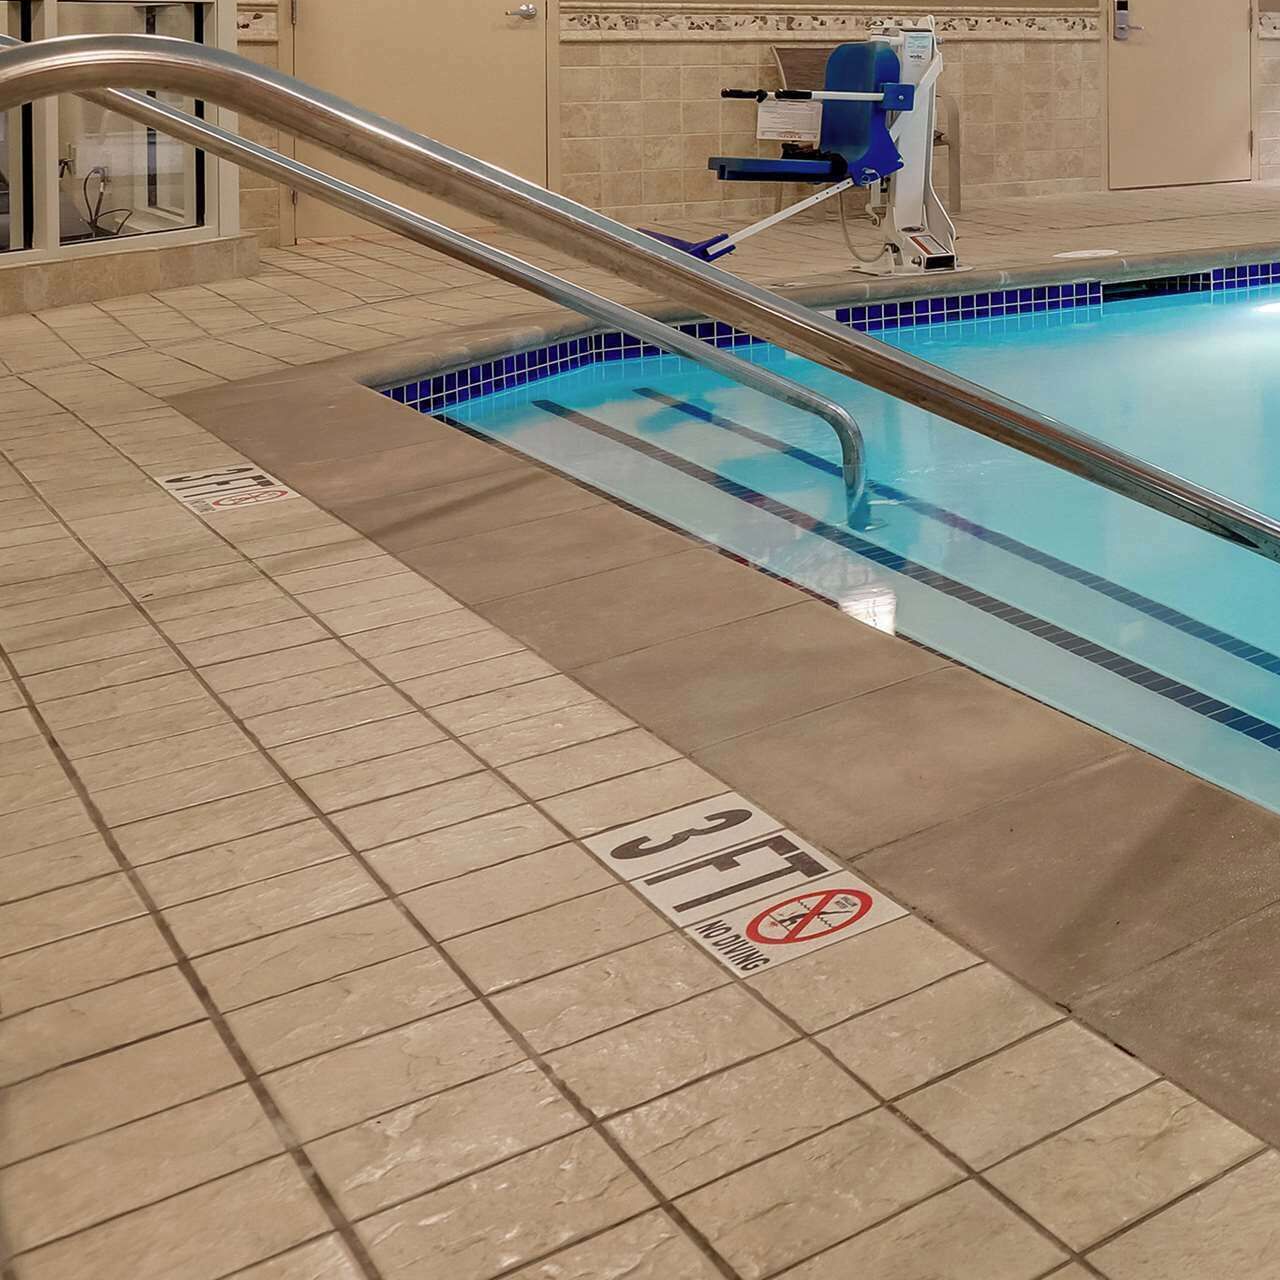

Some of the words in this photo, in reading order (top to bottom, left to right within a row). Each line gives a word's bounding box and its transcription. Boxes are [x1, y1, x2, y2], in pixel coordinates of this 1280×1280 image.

[165, 468, 254, 483] 3
[175, 474, 275, 499] FT
[610, 808, 753, 860] 3
[643, 834, 829, 913] FT
[693, 919, 733, 939] NO
[711, 933, 770, 971] DIVING
